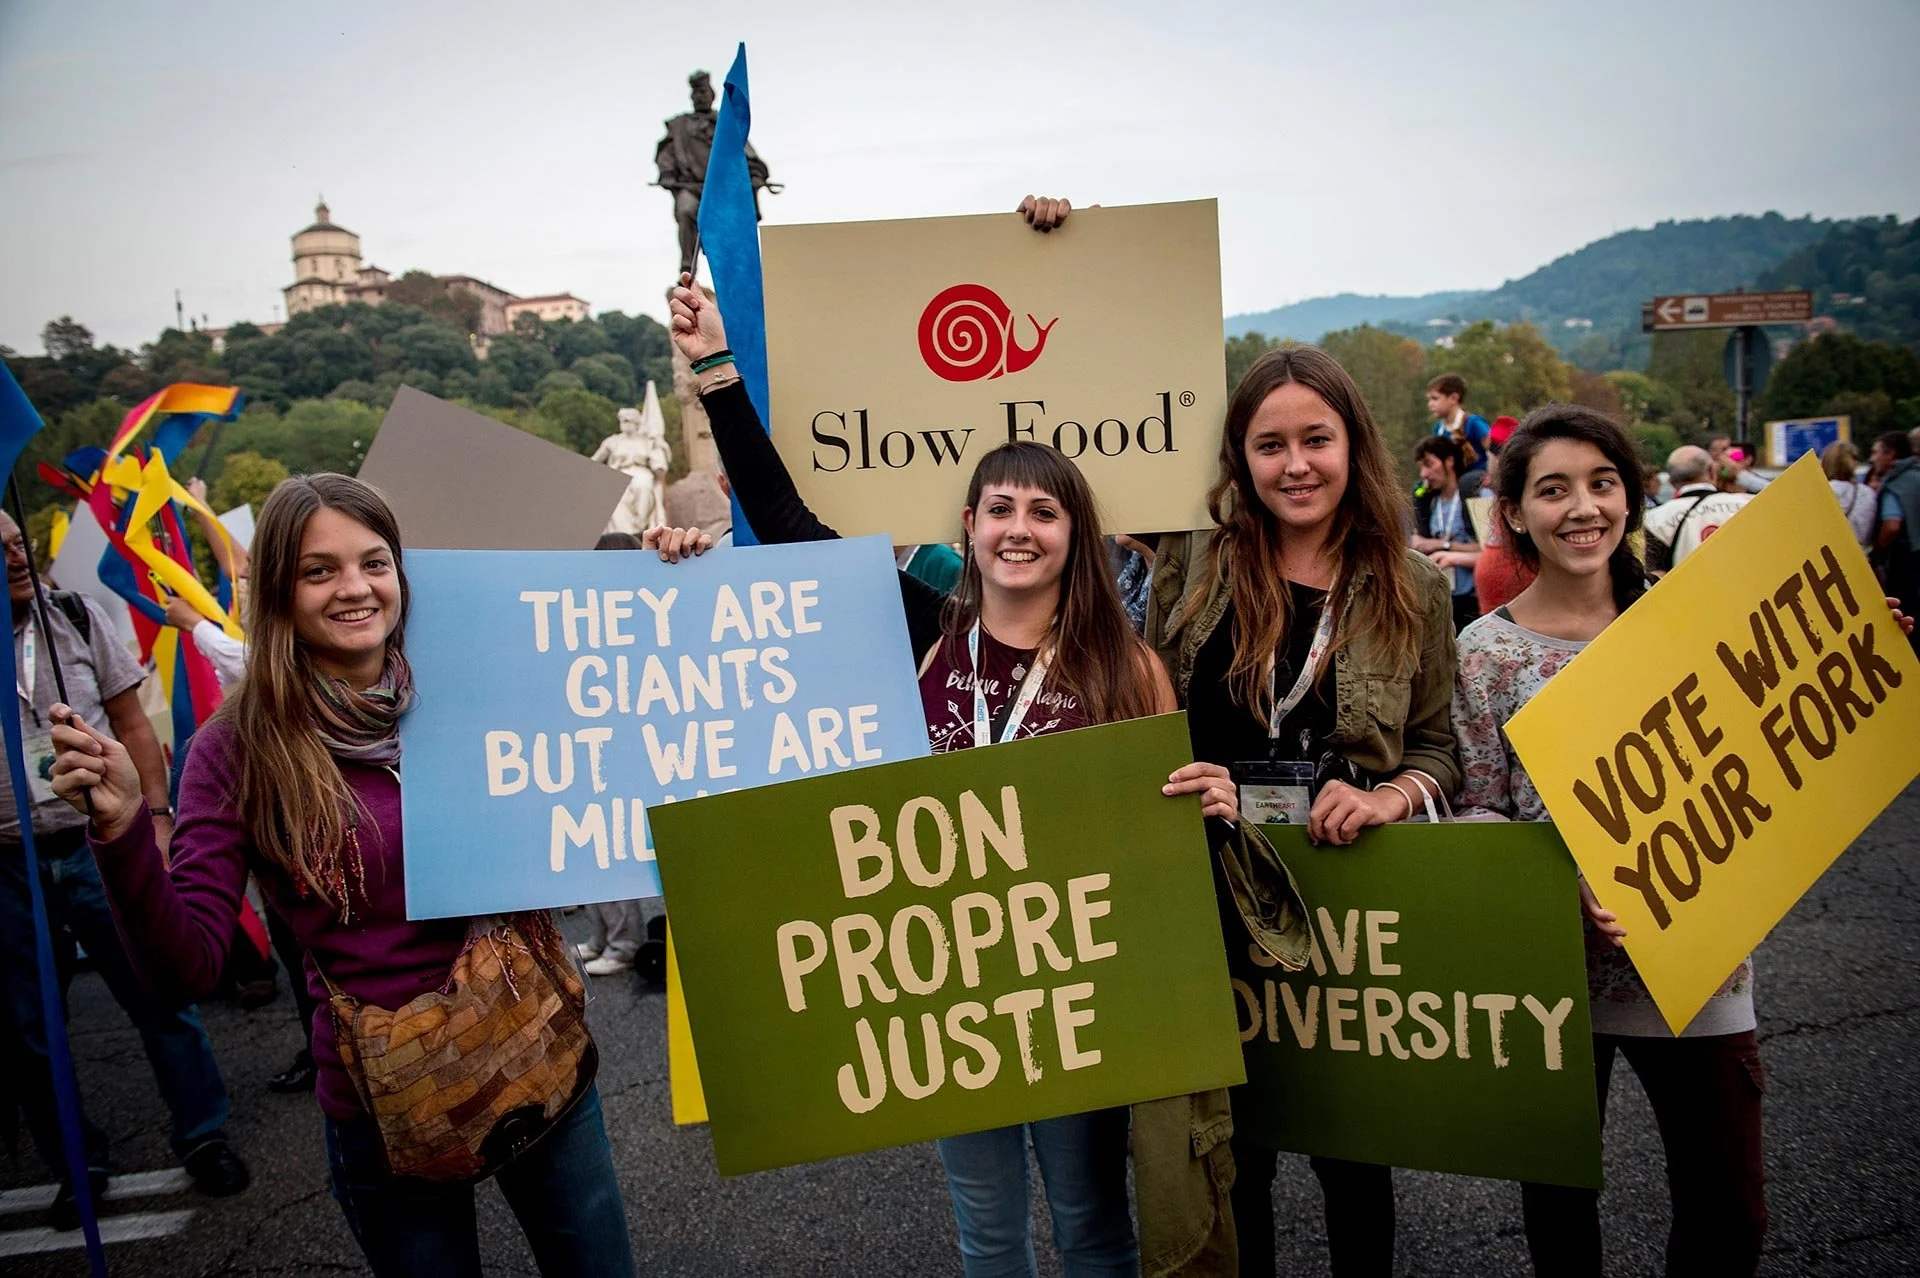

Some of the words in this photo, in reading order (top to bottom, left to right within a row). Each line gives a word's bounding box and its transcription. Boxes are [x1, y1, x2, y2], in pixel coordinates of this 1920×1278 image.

[811, 408, 976, 473] Slow
[519, 587, 678, 652] THEY
[710, 580, 822, 643] ARE
[566, 647, 797, 718] GIANTS
[946, 669, 1000, 695] Belve
[1572, 672, 1724, 845] VOTE
[1715, 544, 1860, 708] WITH
[485, 727, 613, 796] BUT
[642, 720, 738, 786] WE
[768, 704, 882, 775] ARE
[1613, 753, 1773, 931] YOUR
[1759, 622, 1902, 791] FORK
[829, 785, 1029, 899] BON
[1255, 801, 1296, 809] EARTHEART
[776, 872, 1118, 1013] PROPRE
[1248, 906, 1402, 977] VE
[837, 982, 1102, 1114] JUSTE
[1230, 977, 1574, 1071] DIVERSITY
